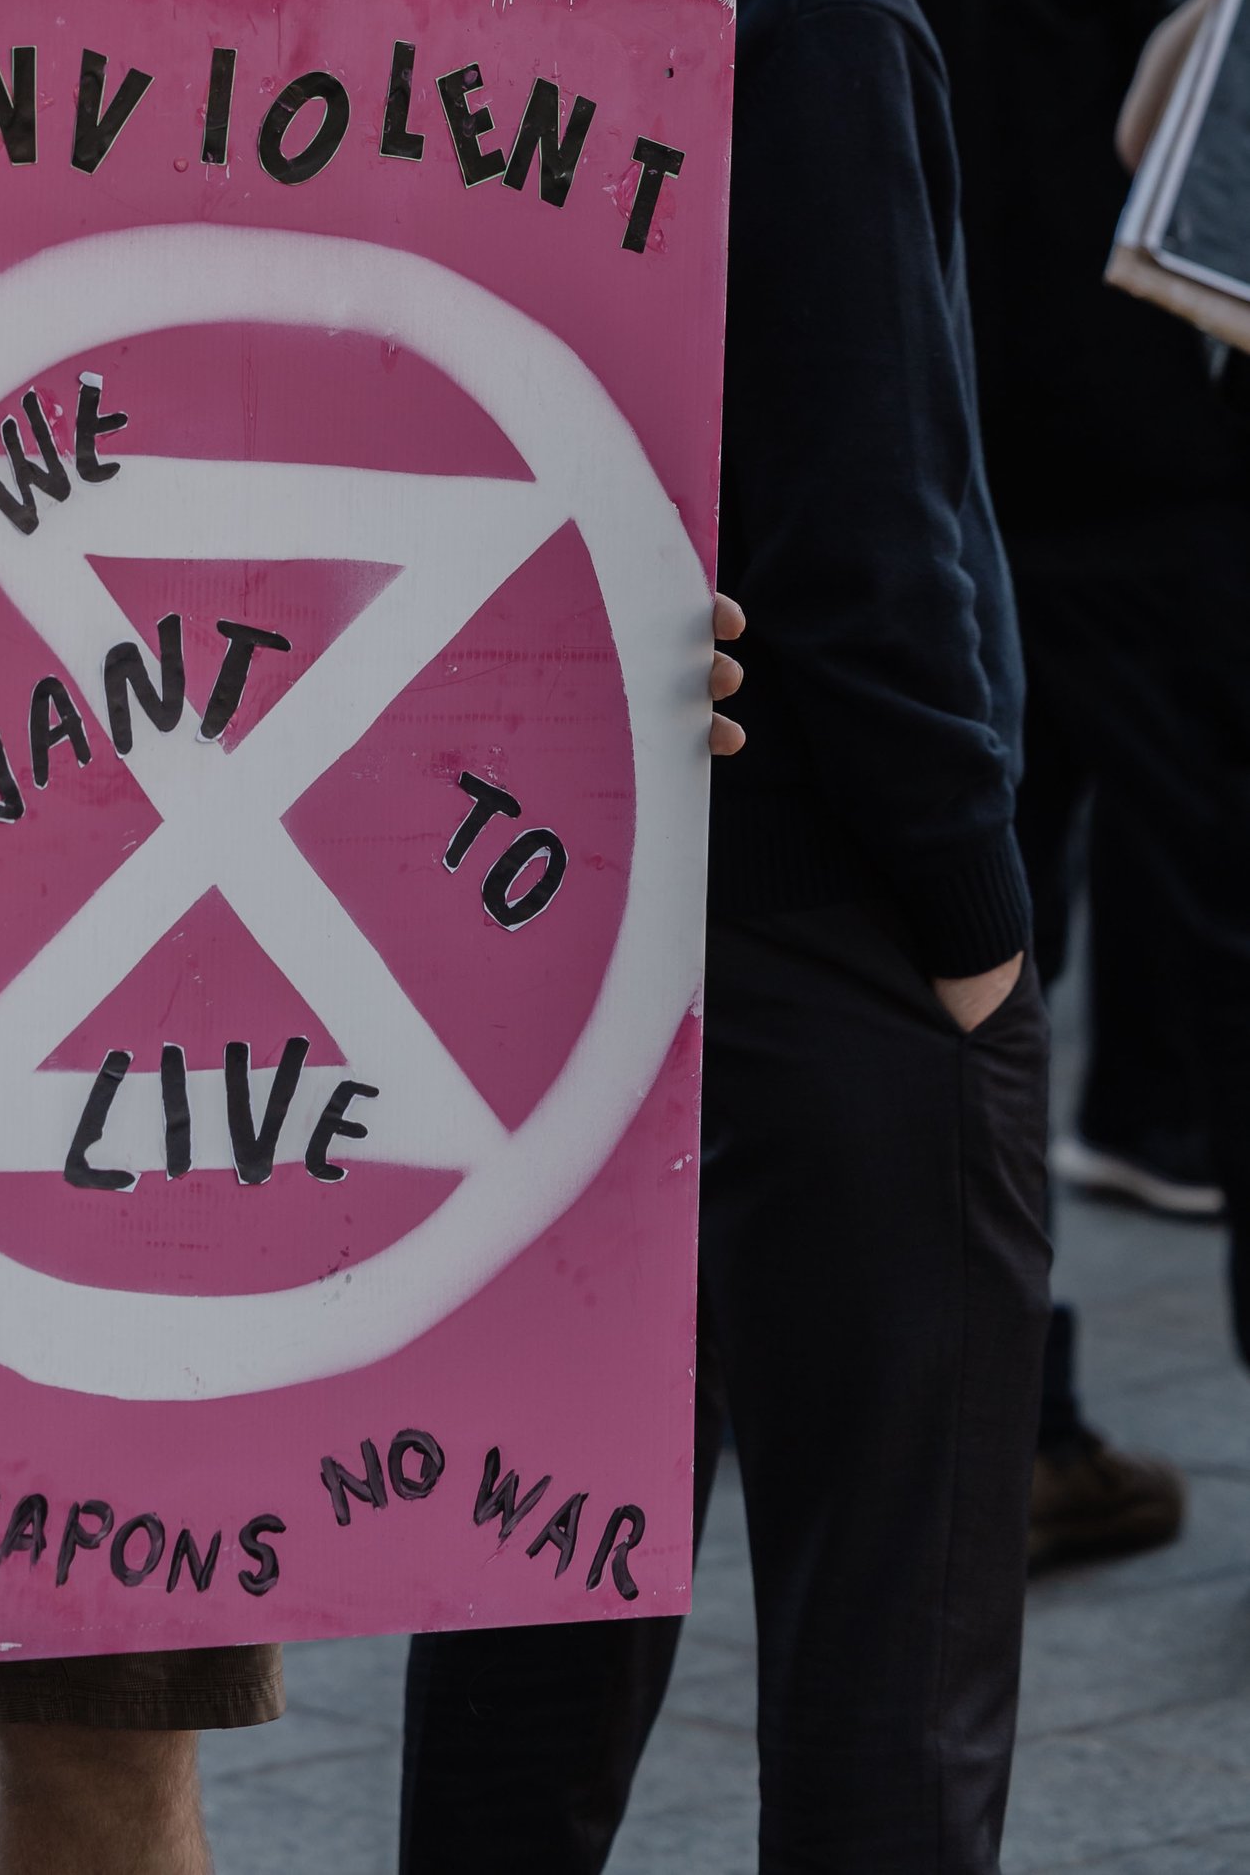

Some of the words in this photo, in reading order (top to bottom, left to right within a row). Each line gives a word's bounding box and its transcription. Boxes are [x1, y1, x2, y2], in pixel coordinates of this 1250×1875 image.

[442, 771, 569, 932] TO
[63, 1035, 380, 1192] LIVE
[320, 1427, 446, 1526] NO
[471, 1445, 647, 1601] WAR
